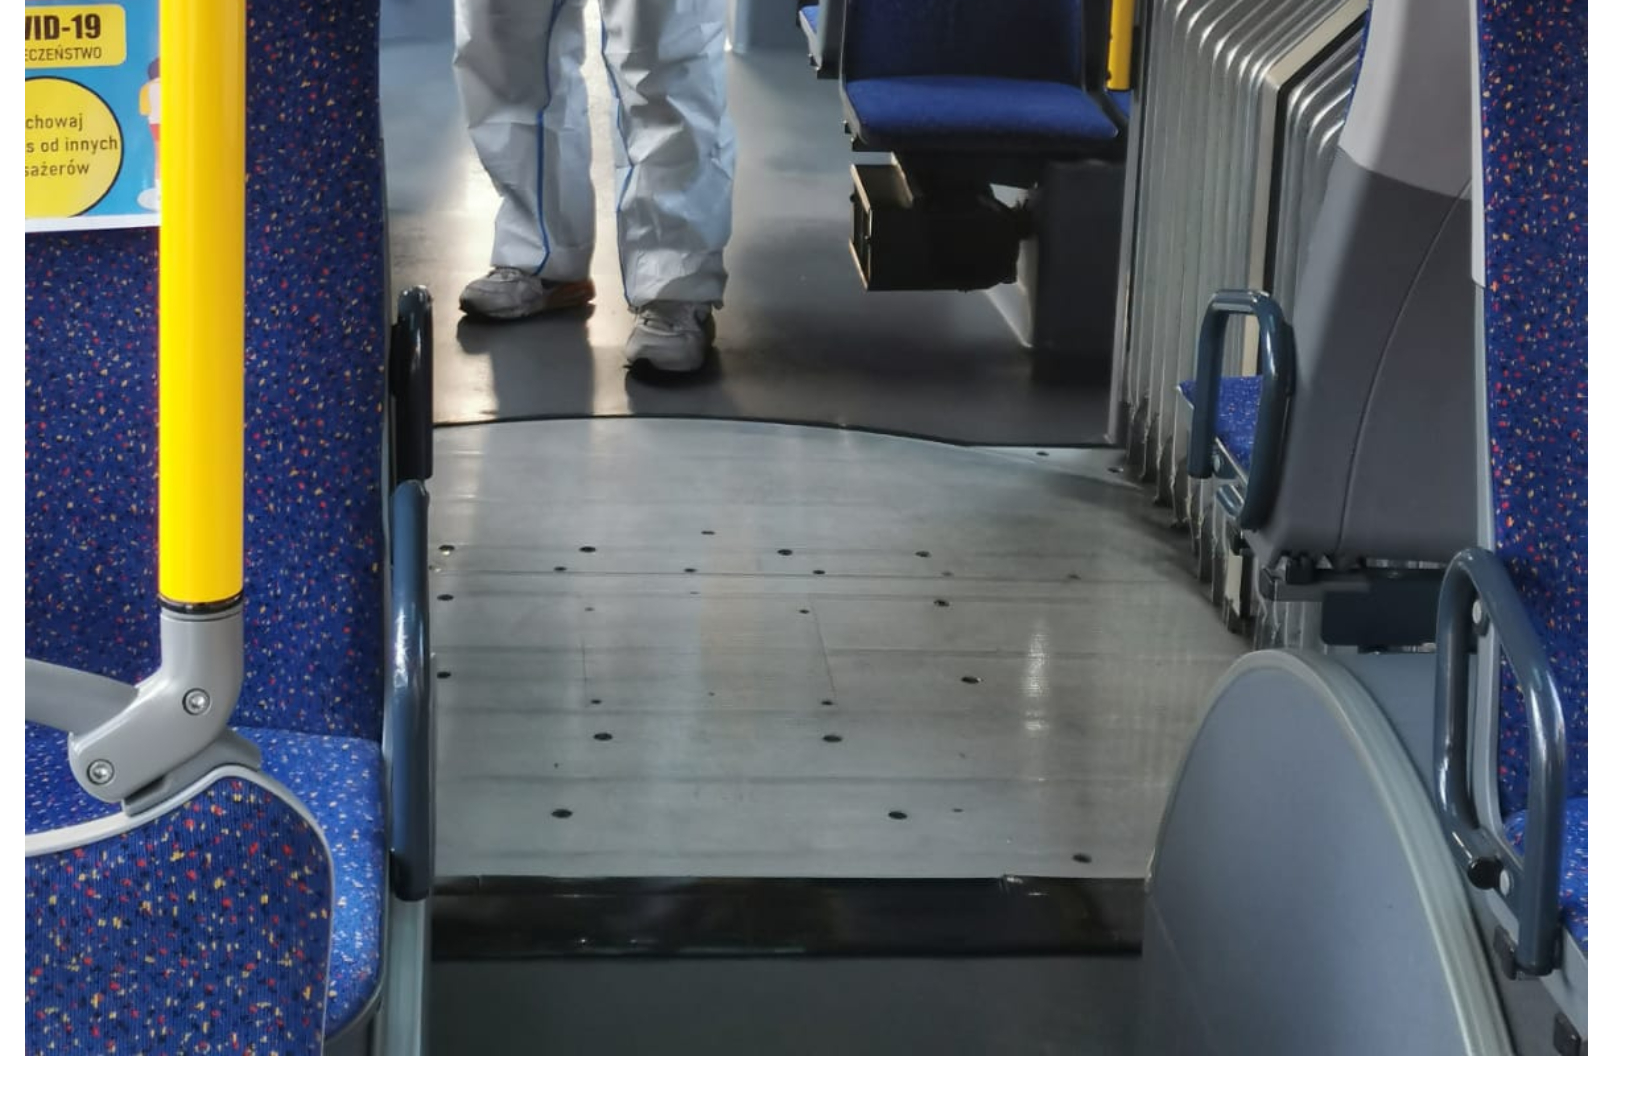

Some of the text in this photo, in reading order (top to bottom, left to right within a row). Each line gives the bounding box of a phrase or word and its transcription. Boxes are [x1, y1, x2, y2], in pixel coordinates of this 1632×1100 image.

[25, 113, 83, 132] chowaj
[41, 137, 59, 152] od
[65, 136, 118, 155] innych
